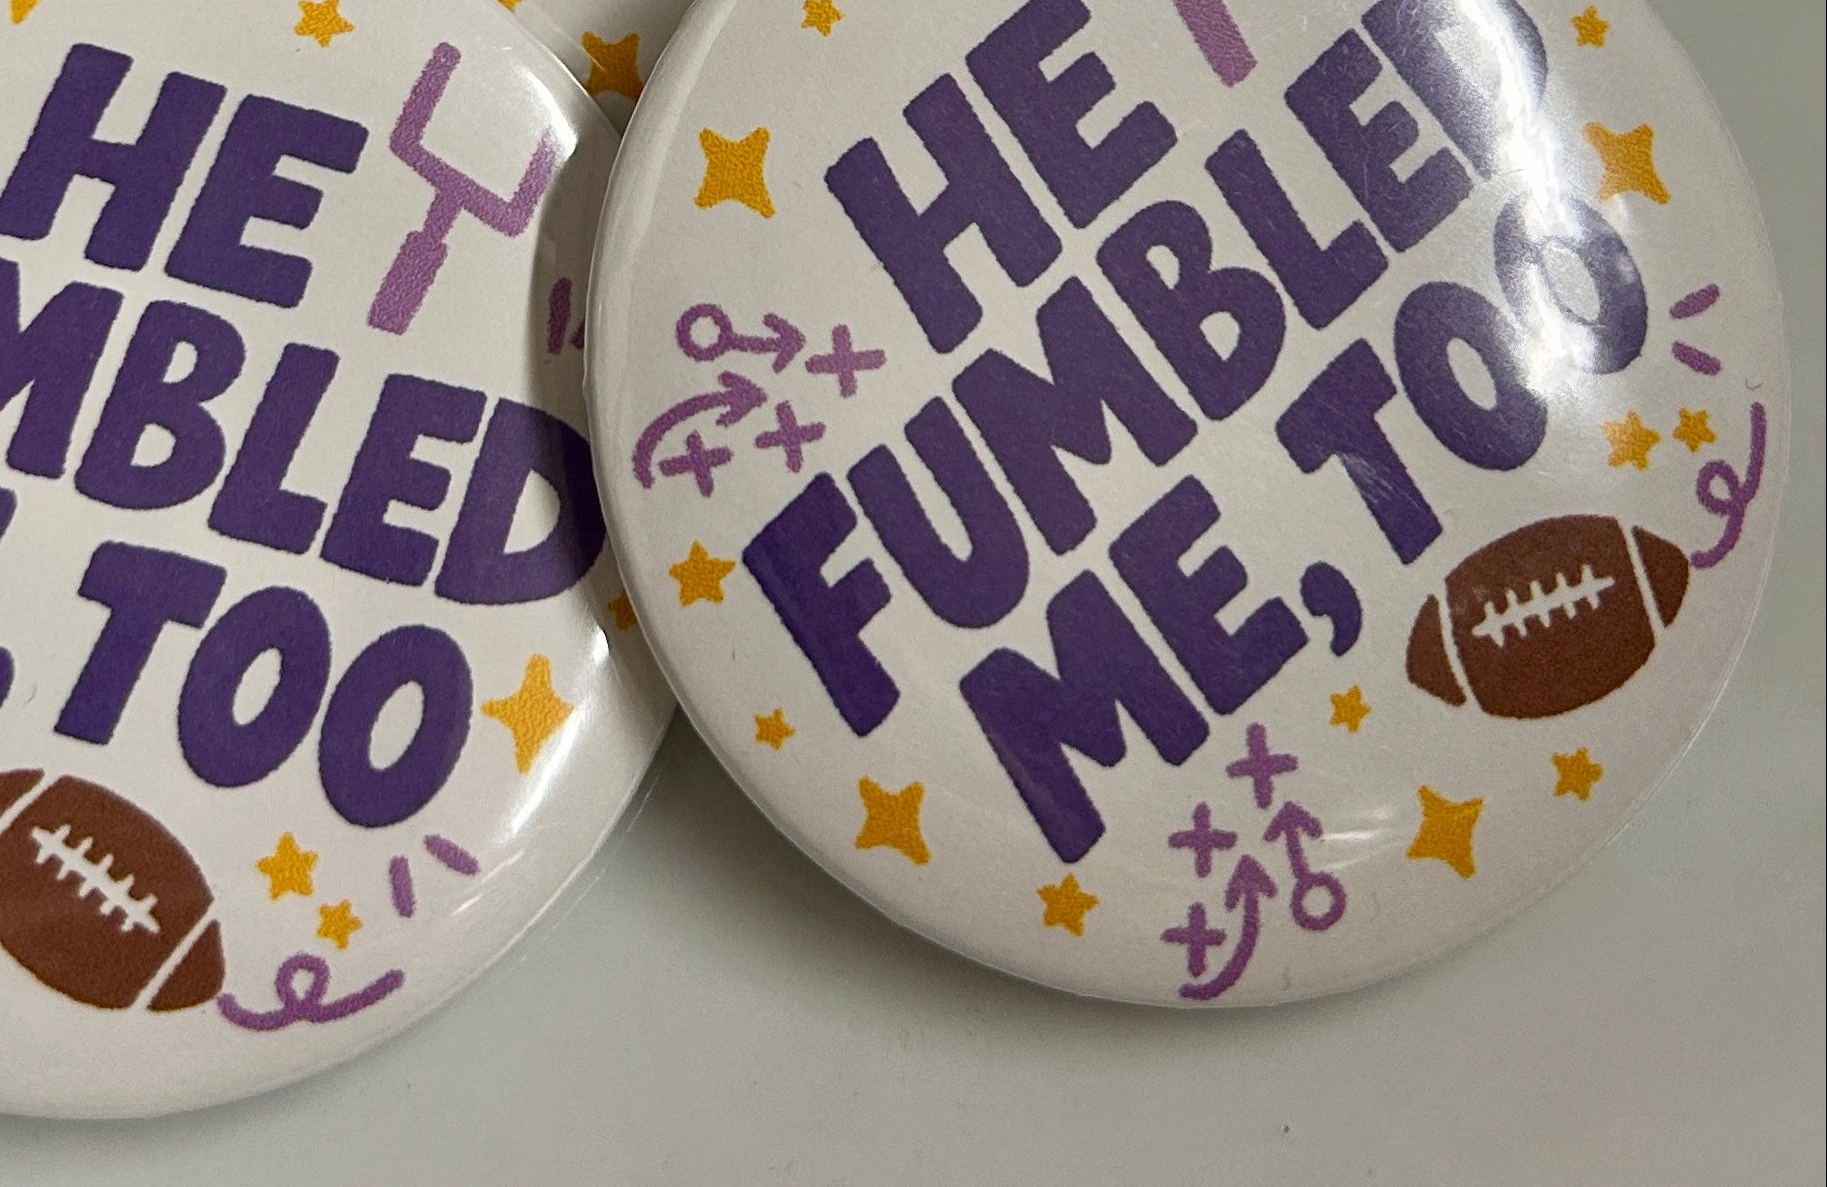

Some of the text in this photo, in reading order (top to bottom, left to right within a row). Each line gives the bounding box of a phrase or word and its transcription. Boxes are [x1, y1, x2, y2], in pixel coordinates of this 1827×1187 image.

[0, 42, 369, 309] HE
[958, 191, 1649, 865] ME, TOO
[53, 541, 473, 830] TOO
